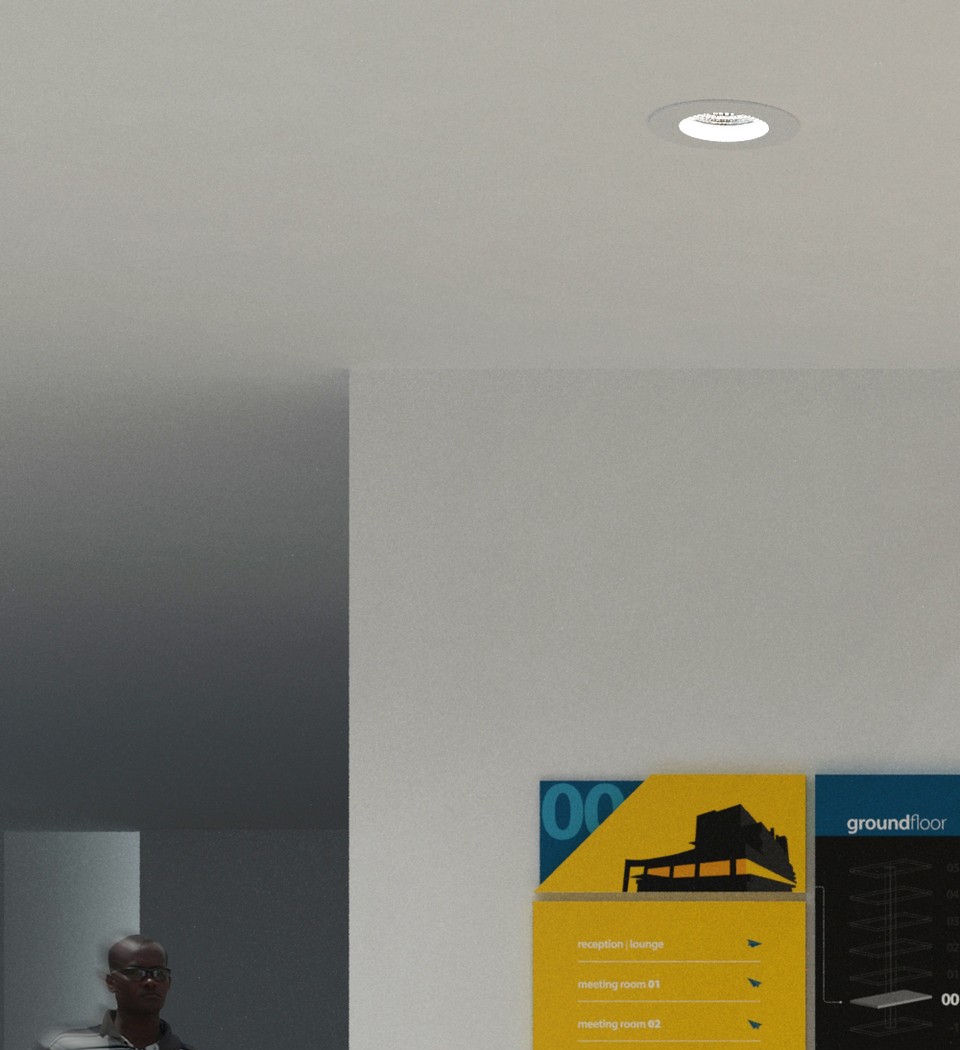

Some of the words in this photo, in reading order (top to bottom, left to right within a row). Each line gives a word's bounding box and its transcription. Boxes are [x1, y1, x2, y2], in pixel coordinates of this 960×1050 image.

[847, 813, 947, 834] groundfloor
[578, 939, 624, 951] reception
[630, 939, 664, 951] lounge
[578, 980, 618, 991] meeting
[647, 980, 660, 988] 01
[941, 992, 960, 1006] 00
[578, 1019, 618, 1031] meeting
[620, 1020, 646, 1028] room
[647, 1019, 661, 1028] 02
